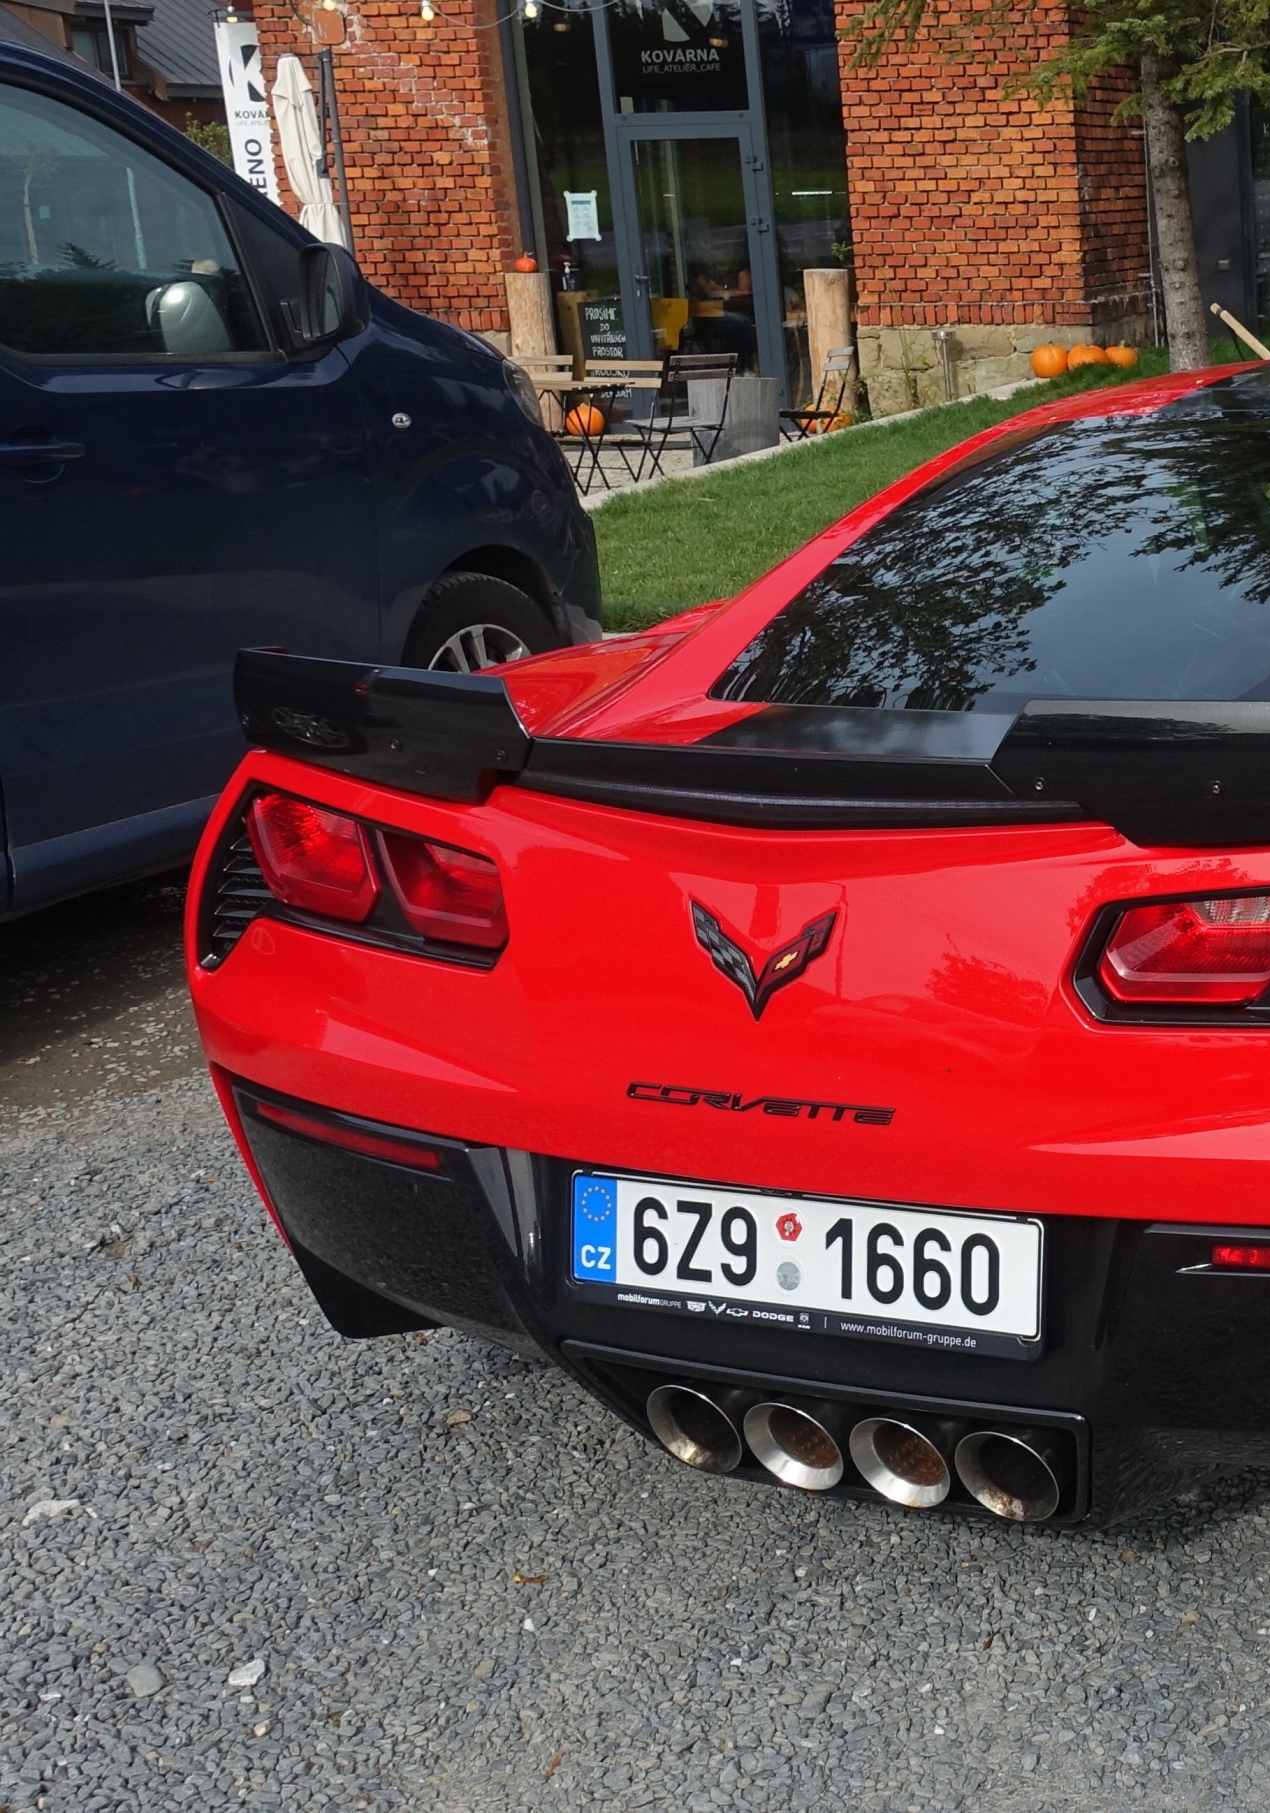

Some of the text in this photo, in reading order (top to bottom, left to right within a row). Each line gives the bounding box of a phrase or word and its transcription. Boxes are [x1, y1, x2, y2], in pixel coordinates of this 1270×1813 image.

[244, 138, 268, 197] ENO
[600, 323, 610, 332] DO
[592, 346, 624, 358] PROSTOR
[626, 1081, 896, 1126] CORVETTE
[580, 1244, 612, 1271] CZ
[633, 1196, 1001, 1317] 6Z9 1660
[752, 1310, 795, 1323] DODGE
[840, 1321, 977, 1348] www.mobilforum-gruppe.de
